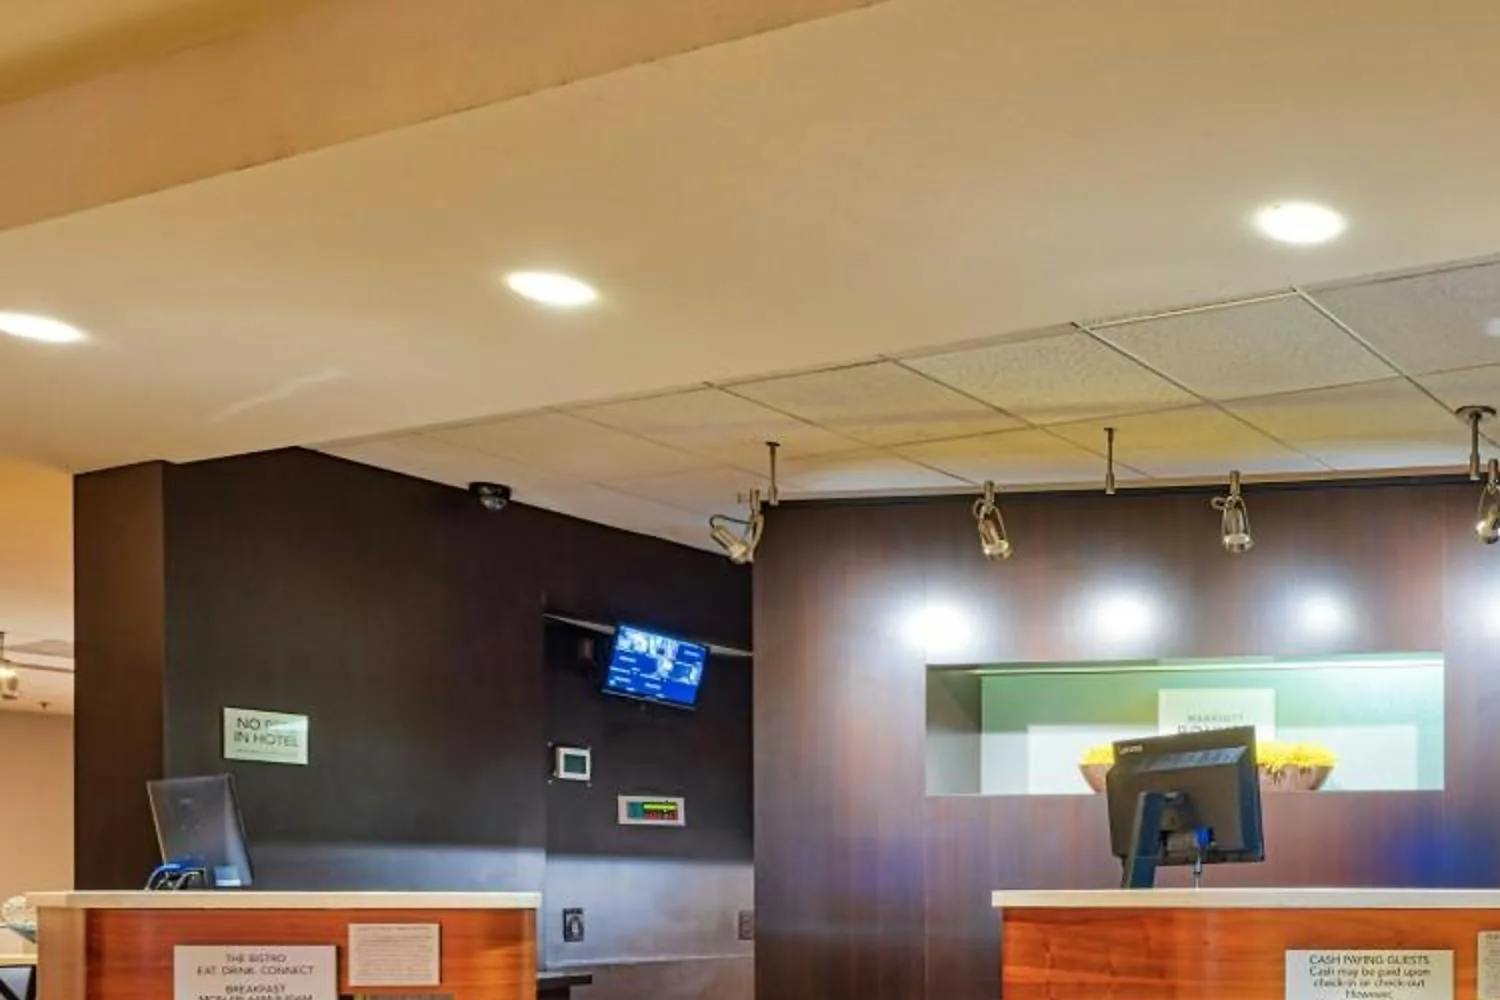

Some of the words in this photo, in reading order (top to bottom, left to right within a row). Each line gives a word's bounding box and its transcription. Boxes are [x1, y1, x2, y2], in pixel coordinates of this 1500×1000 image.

[237, 717, 261, 730] NO
[252, 733, 300, 748] HOTEL
[225, 953, 245, 963] THE
[1309, 955, 1341, 965] CASH
[1343, 955, 1383, 965] PAYING
[1387, 955, 1430, 965] GUESTS
[1309, 966, 1335, 977] Cash
[1338, 968, 1358, 978] may
[1361, 966, 1374, 976] be
[1377, 966, 1400, 978] paid
[1403, 968, 1431, 978] upon
[225, 985, 286, 995] BREAKFAST
